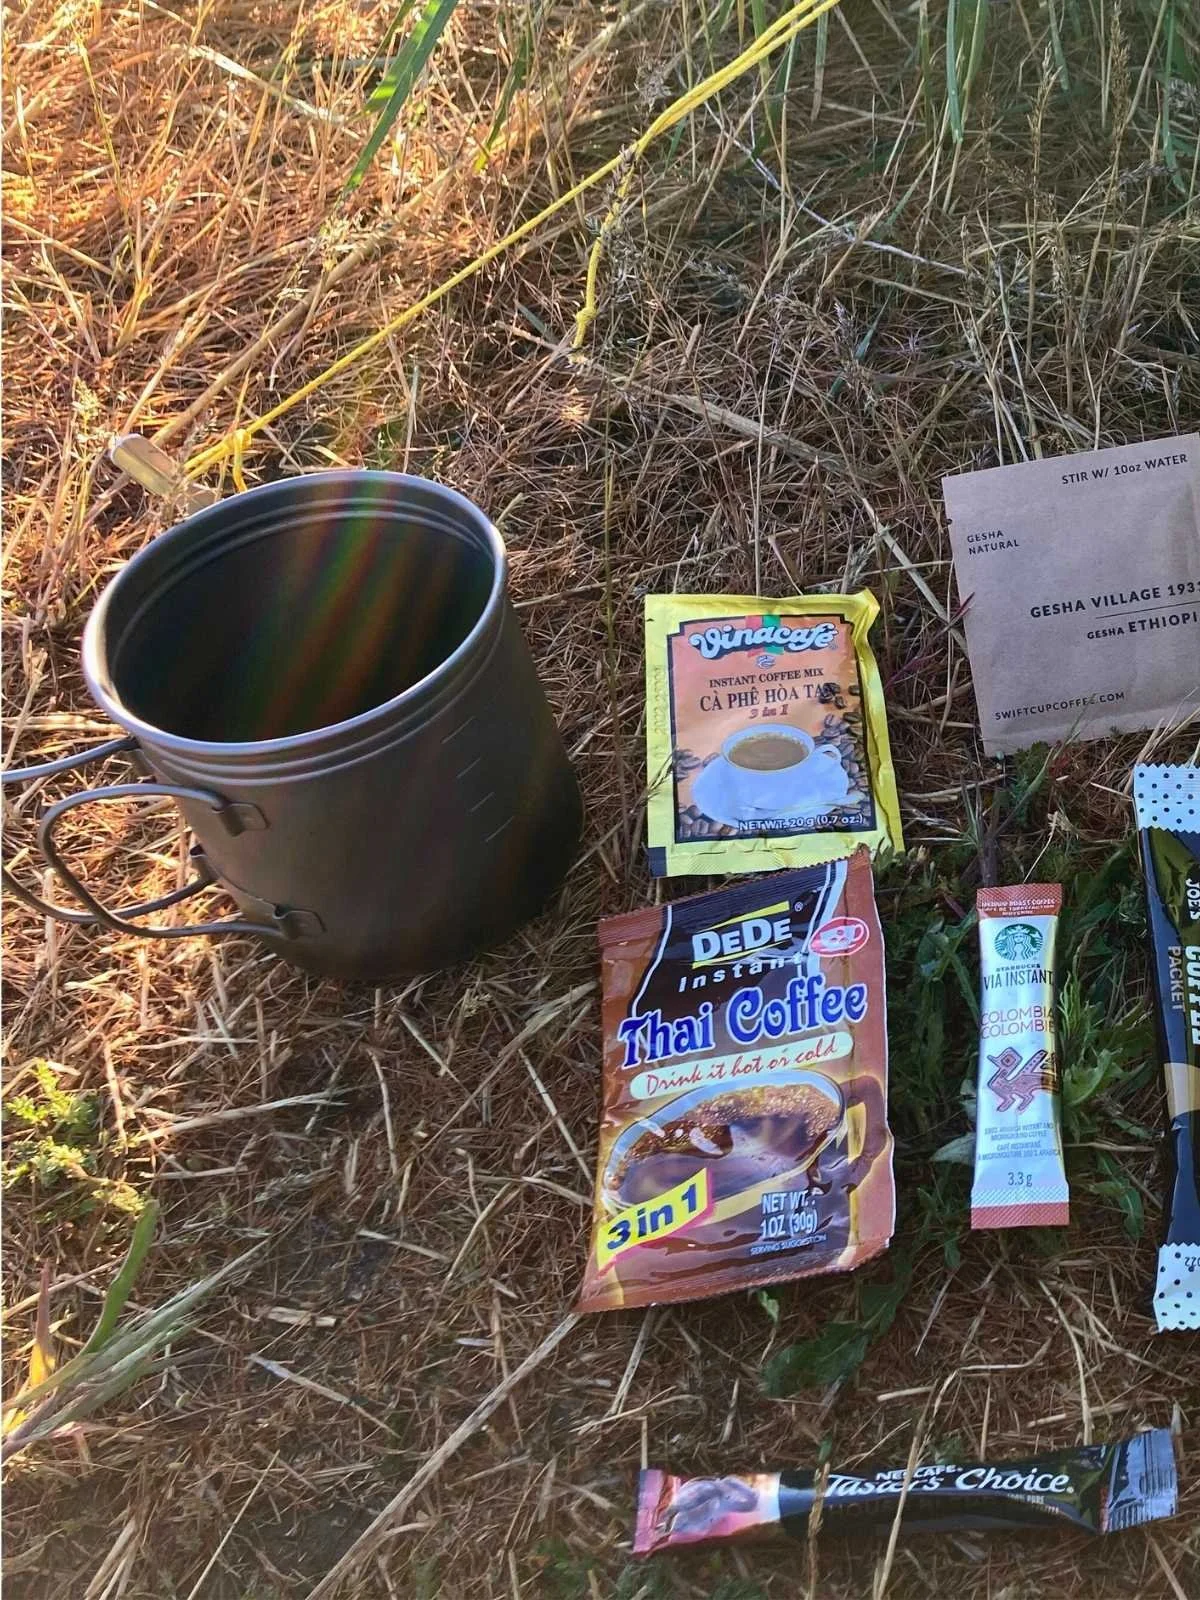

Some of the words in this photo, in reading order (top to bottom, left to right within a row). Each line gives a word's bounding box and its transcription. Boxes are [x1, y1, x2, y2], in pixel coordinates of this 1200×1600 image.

[1062, 471, 1089, 485] STIR
[1092, 468, 1108, 480] W/
[1114, 462, 1142, 477] 10oz
[1145, 454, 1188, 470] WATER
[967, 530, 1004, 543] GESHA
[969, 539, 1020, 555] NATURAL
[1031, 600, 1085, 618] GESHA
[1091, 587, 1161, 608] VILLAGE
[1087, 627, 1124, 639] GESHA
[710, 674, 757, 688] INSTANT
[759, 671, 801, 682] COFFEE
[804, 668, 824, 677] MIX
[700, 690, 723, 712] CÀ
[728, 688, 760, 709] PHÊ
[765, 684, 799, 703] HÒA
[750, 708, 758, 719] 3
[762, 707, 778, 717] in
[740, 820, 760, 831] NET
[788, 818, 807, 828] 20
[817, 815, 839, 827] (0.7
[678, 952, 804, 993] Instant
[984, 973, 1005, 990] VIA
[1006, 969, 1053, 987] INSTANT
[1167, 945, 1186, 1012] PACKET
[617, 1001, 716, 1070] Thai
[725, 972, 867, 1045] Coffee
[646, 1068, 702, 1097] Drink
[707, 1063, 726, 1080] it
[731, 1056, 763, 1076] hot
[769, 1055, 790, 1070] or
[796, 1035, 837, 1065] cold
[1008, 1172, 1024, 1185] 3.3
[1026, 1174, 1032, 1187] g
[607, 1219, 632, 1249] 3
[637, 1204, 673, 1238] in
[681, 1183, 697, 1214] 1
[762, 1192, 785, 1214] NET
[789, 1209, 818, 1237] (30g)
[954, 1467, 1070, 1493] Choice
